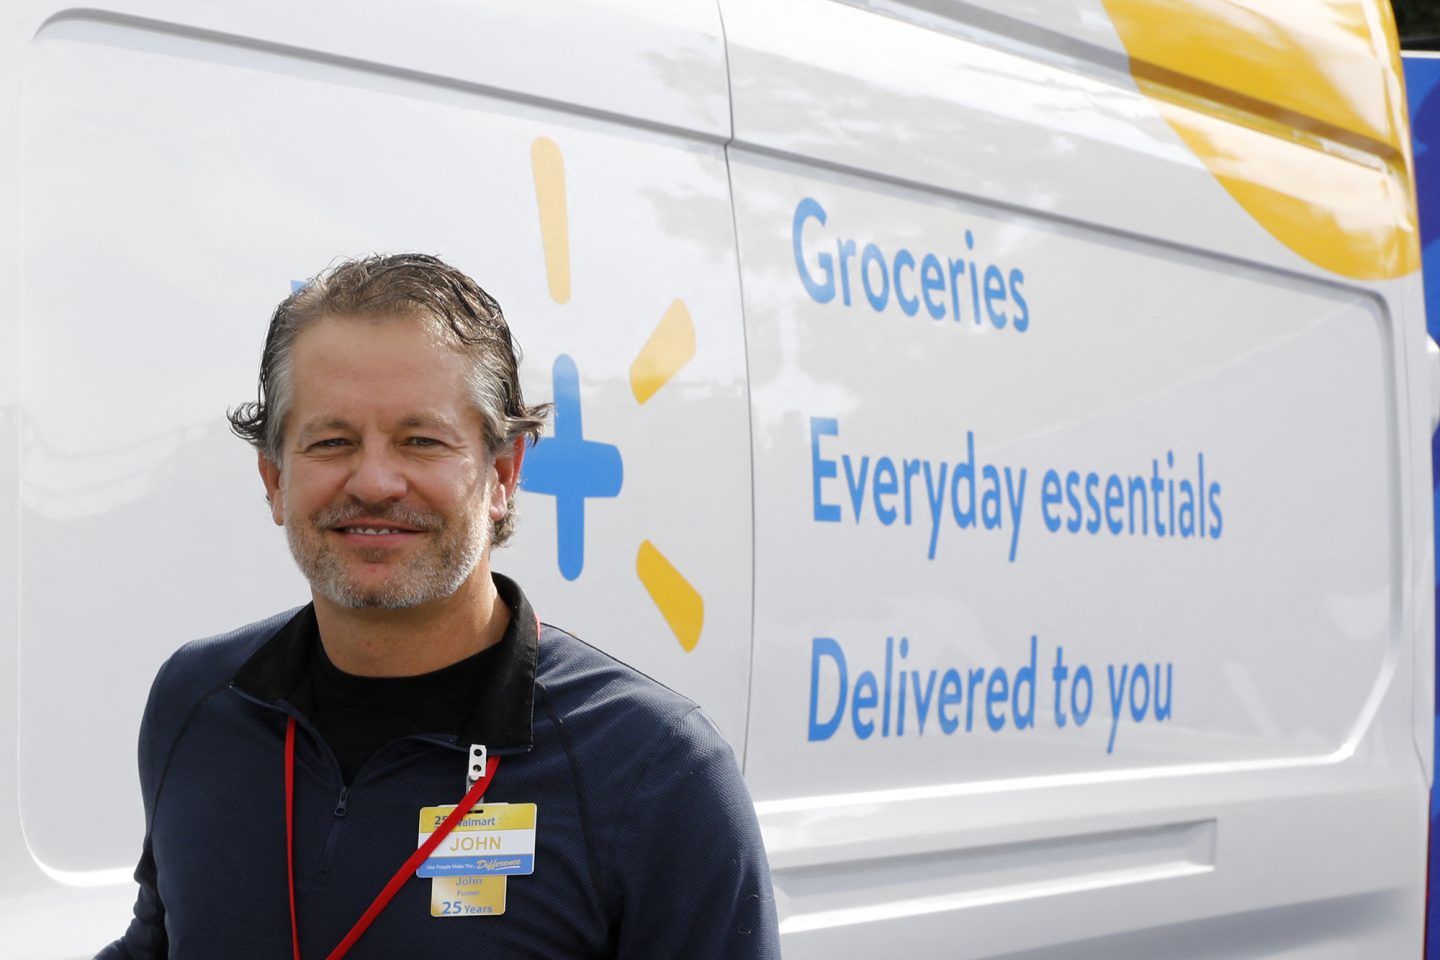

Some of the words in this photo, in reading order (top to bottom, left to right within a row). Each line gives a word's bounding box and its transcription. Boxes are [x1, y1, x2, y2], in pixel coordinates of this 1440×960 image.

[792, 197, 1030, 333] Groceries
[809, 416, 1028, 563] Everyday
[1041, 450, 1224, 540] essentials
[807, 634, 1038, 742] Delivered
[1052, 646, 1093, 728] to
[1107, 662, 1173, 754] you
[450, 836, 501, 851] JOHN
[476, 859, 522, 871] Difference
[456, 876, 482, 886] John
[442, 901, 462, 914] 25
[464, 904, 493, 914] Years
